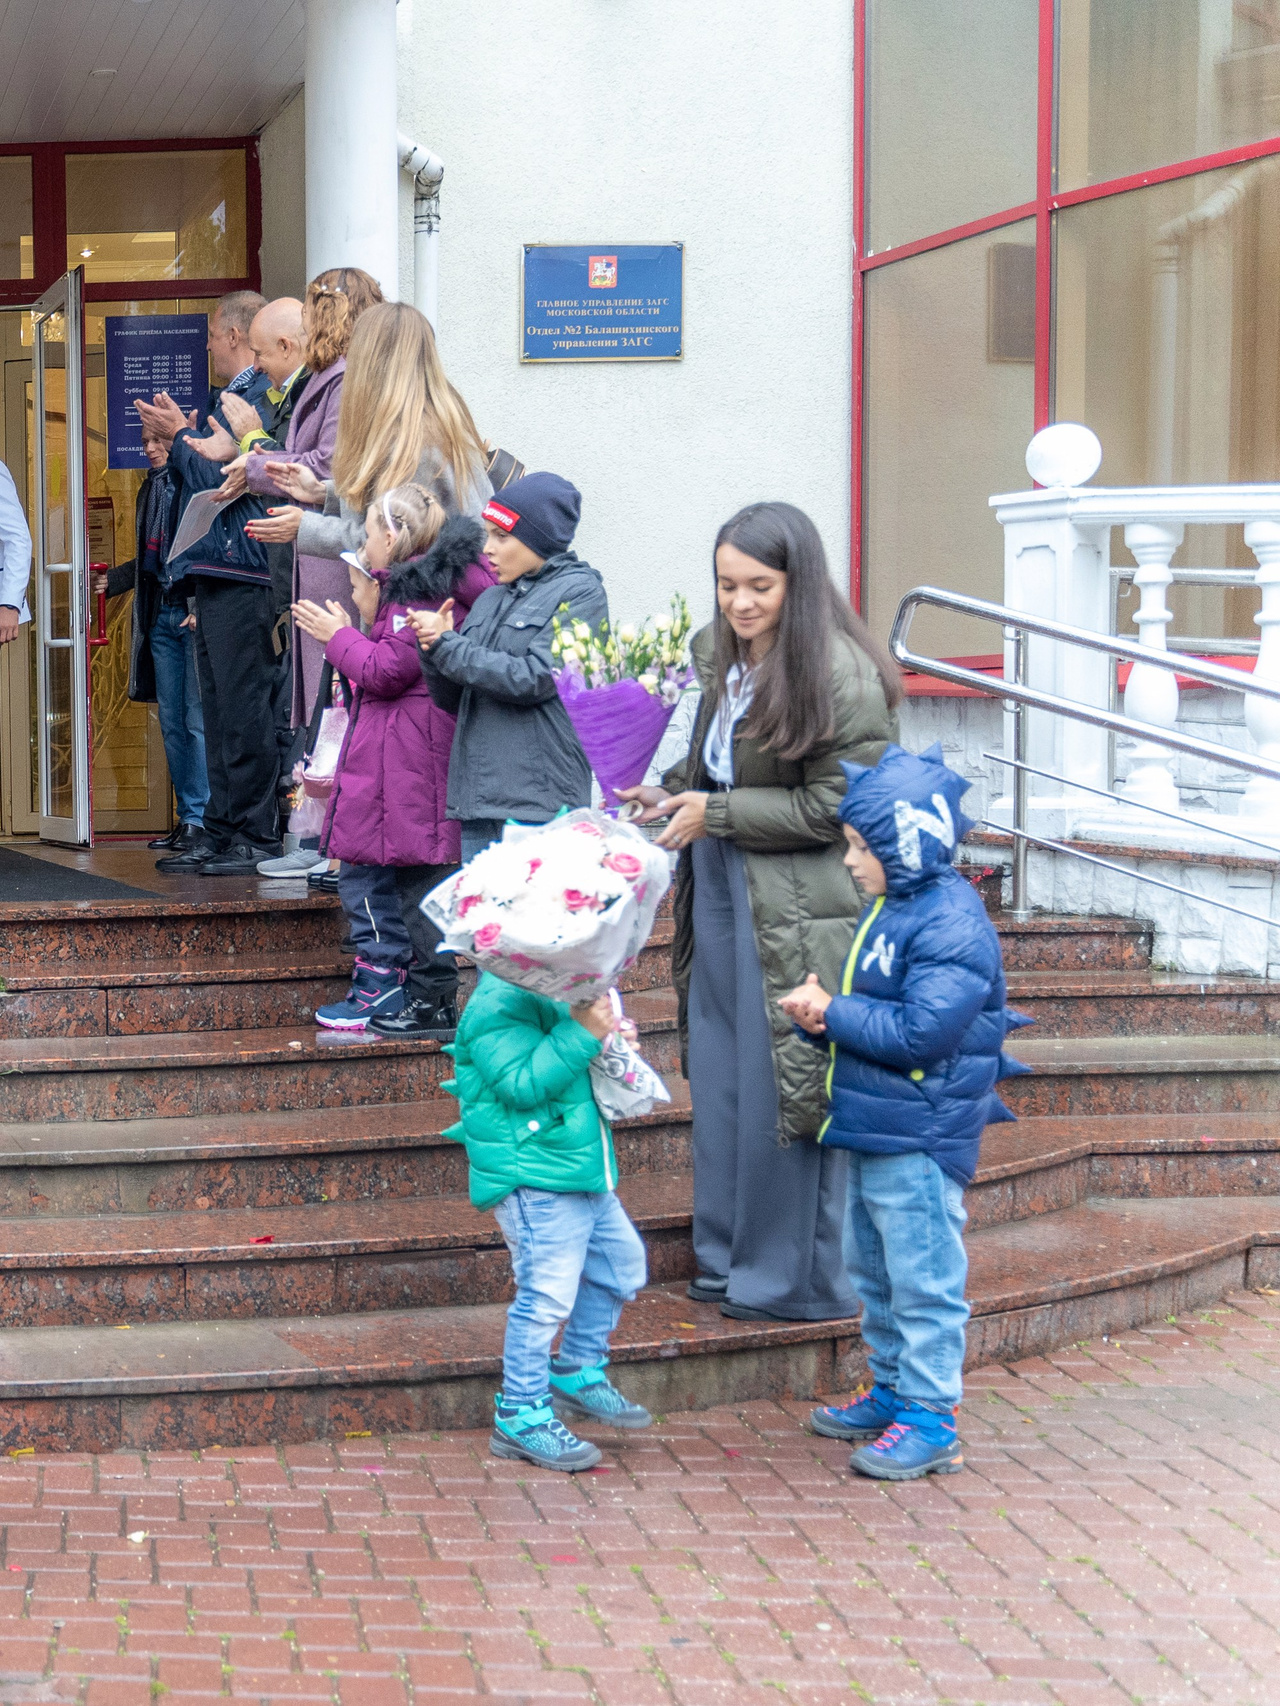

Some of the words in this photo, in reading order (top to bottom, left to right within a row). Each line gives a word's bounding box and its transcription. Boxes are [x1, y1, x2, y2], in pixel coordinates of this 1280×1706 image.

[536, 299, 580, 308] ГЛАВНОЕ
[582, 298, 645, 307] УПРАВЛЕНИЕ
[646, 298, 670, 306] ЗАГС
[546, 307, 613, 316] МОСКОВСКОЙ
[615, 308, 660, 316] ОБЛАСТИ
[526, 326, 560, 336] Отдел
[563, 326, 582, 335] №2
[585, 325, 679, 335] Балашихинского
[552, 340, 618, 350] управления
[621, 337, 653, 346] ЗАГС
